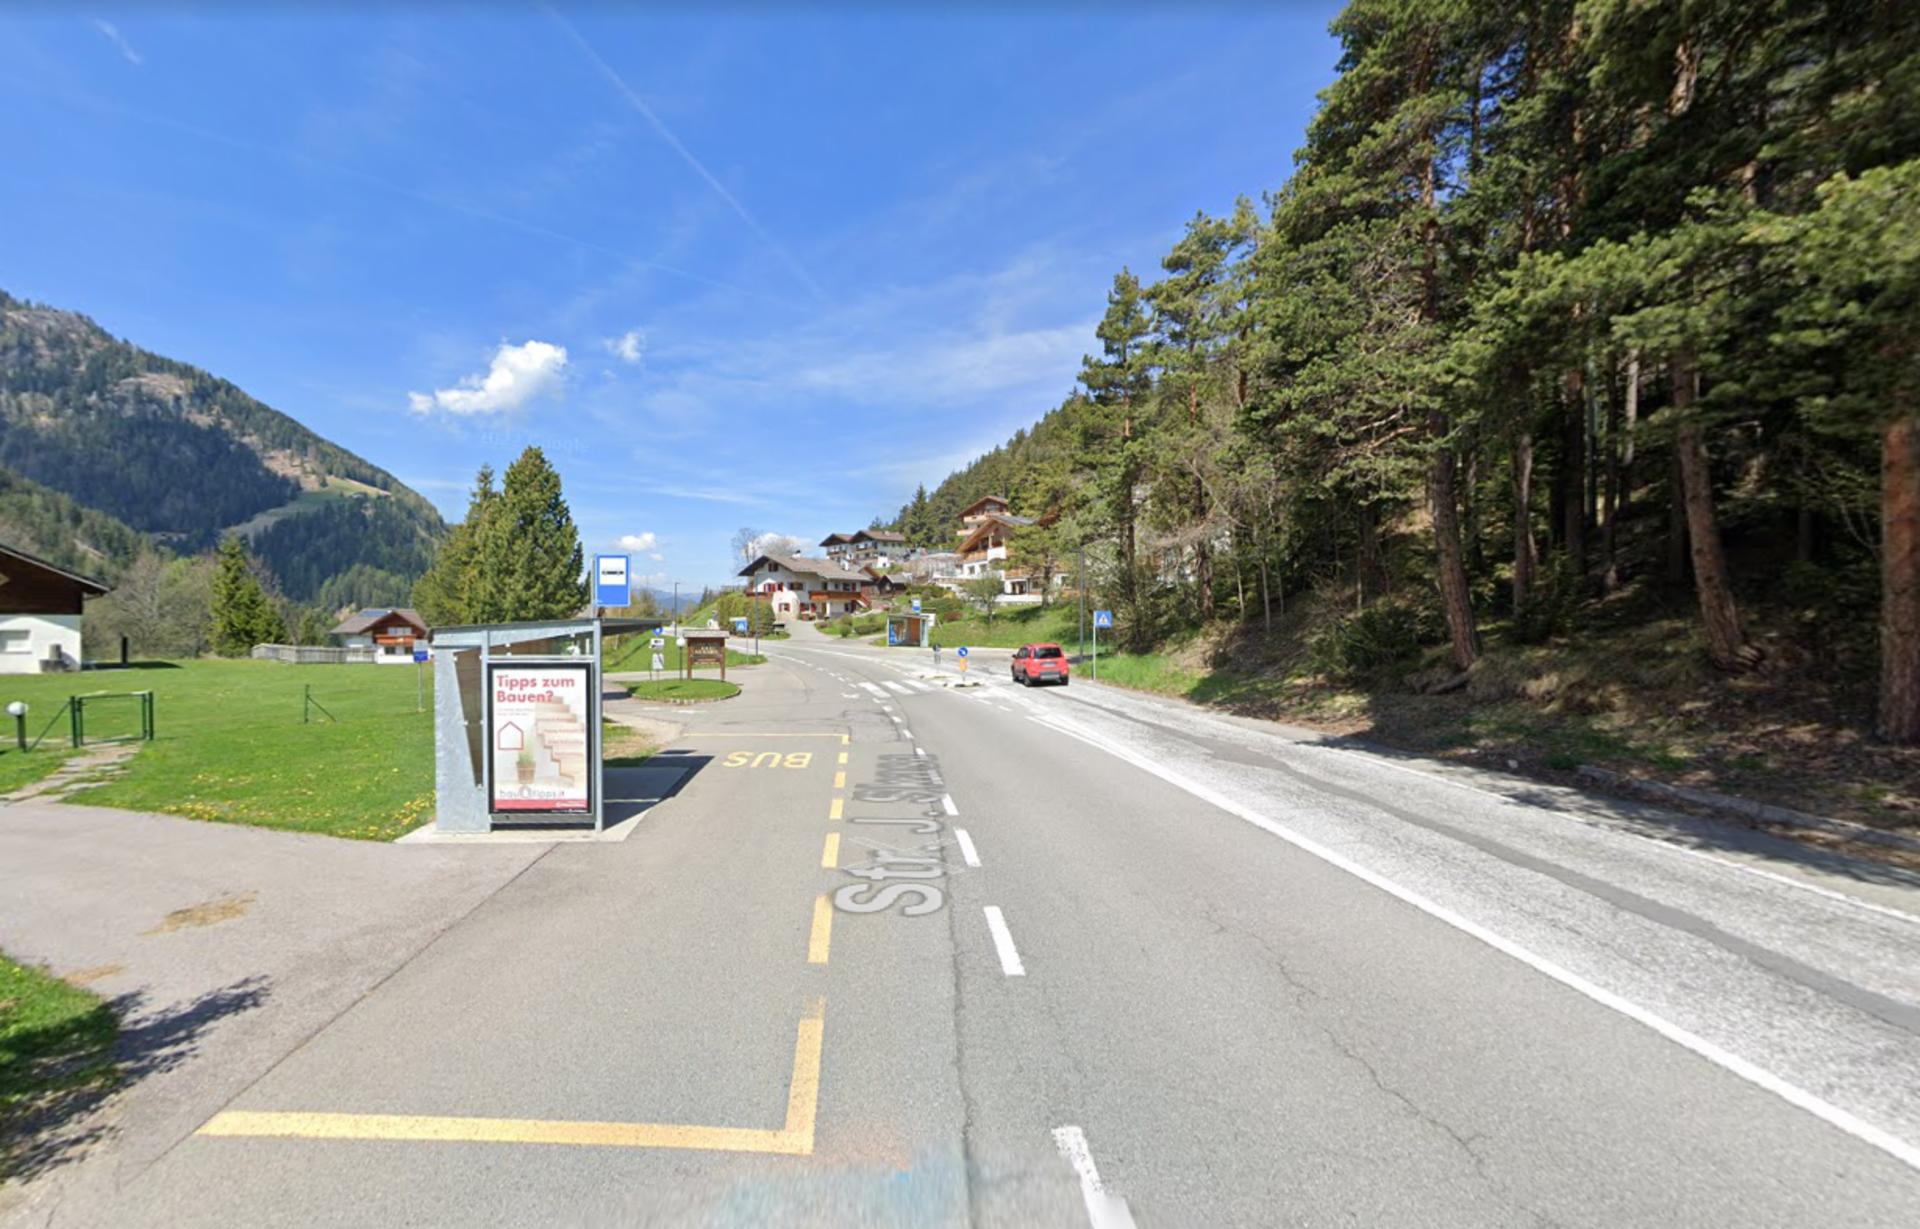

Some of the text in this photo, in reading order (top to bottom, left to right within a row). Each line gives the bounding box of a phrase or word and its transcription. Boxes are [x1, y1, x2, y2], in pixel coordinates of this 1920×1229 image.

[496, 675, 575, 691] Tipps zum
[496, 690, 554, 703] Bauen?
[722, 751, 813, 769] BUS
